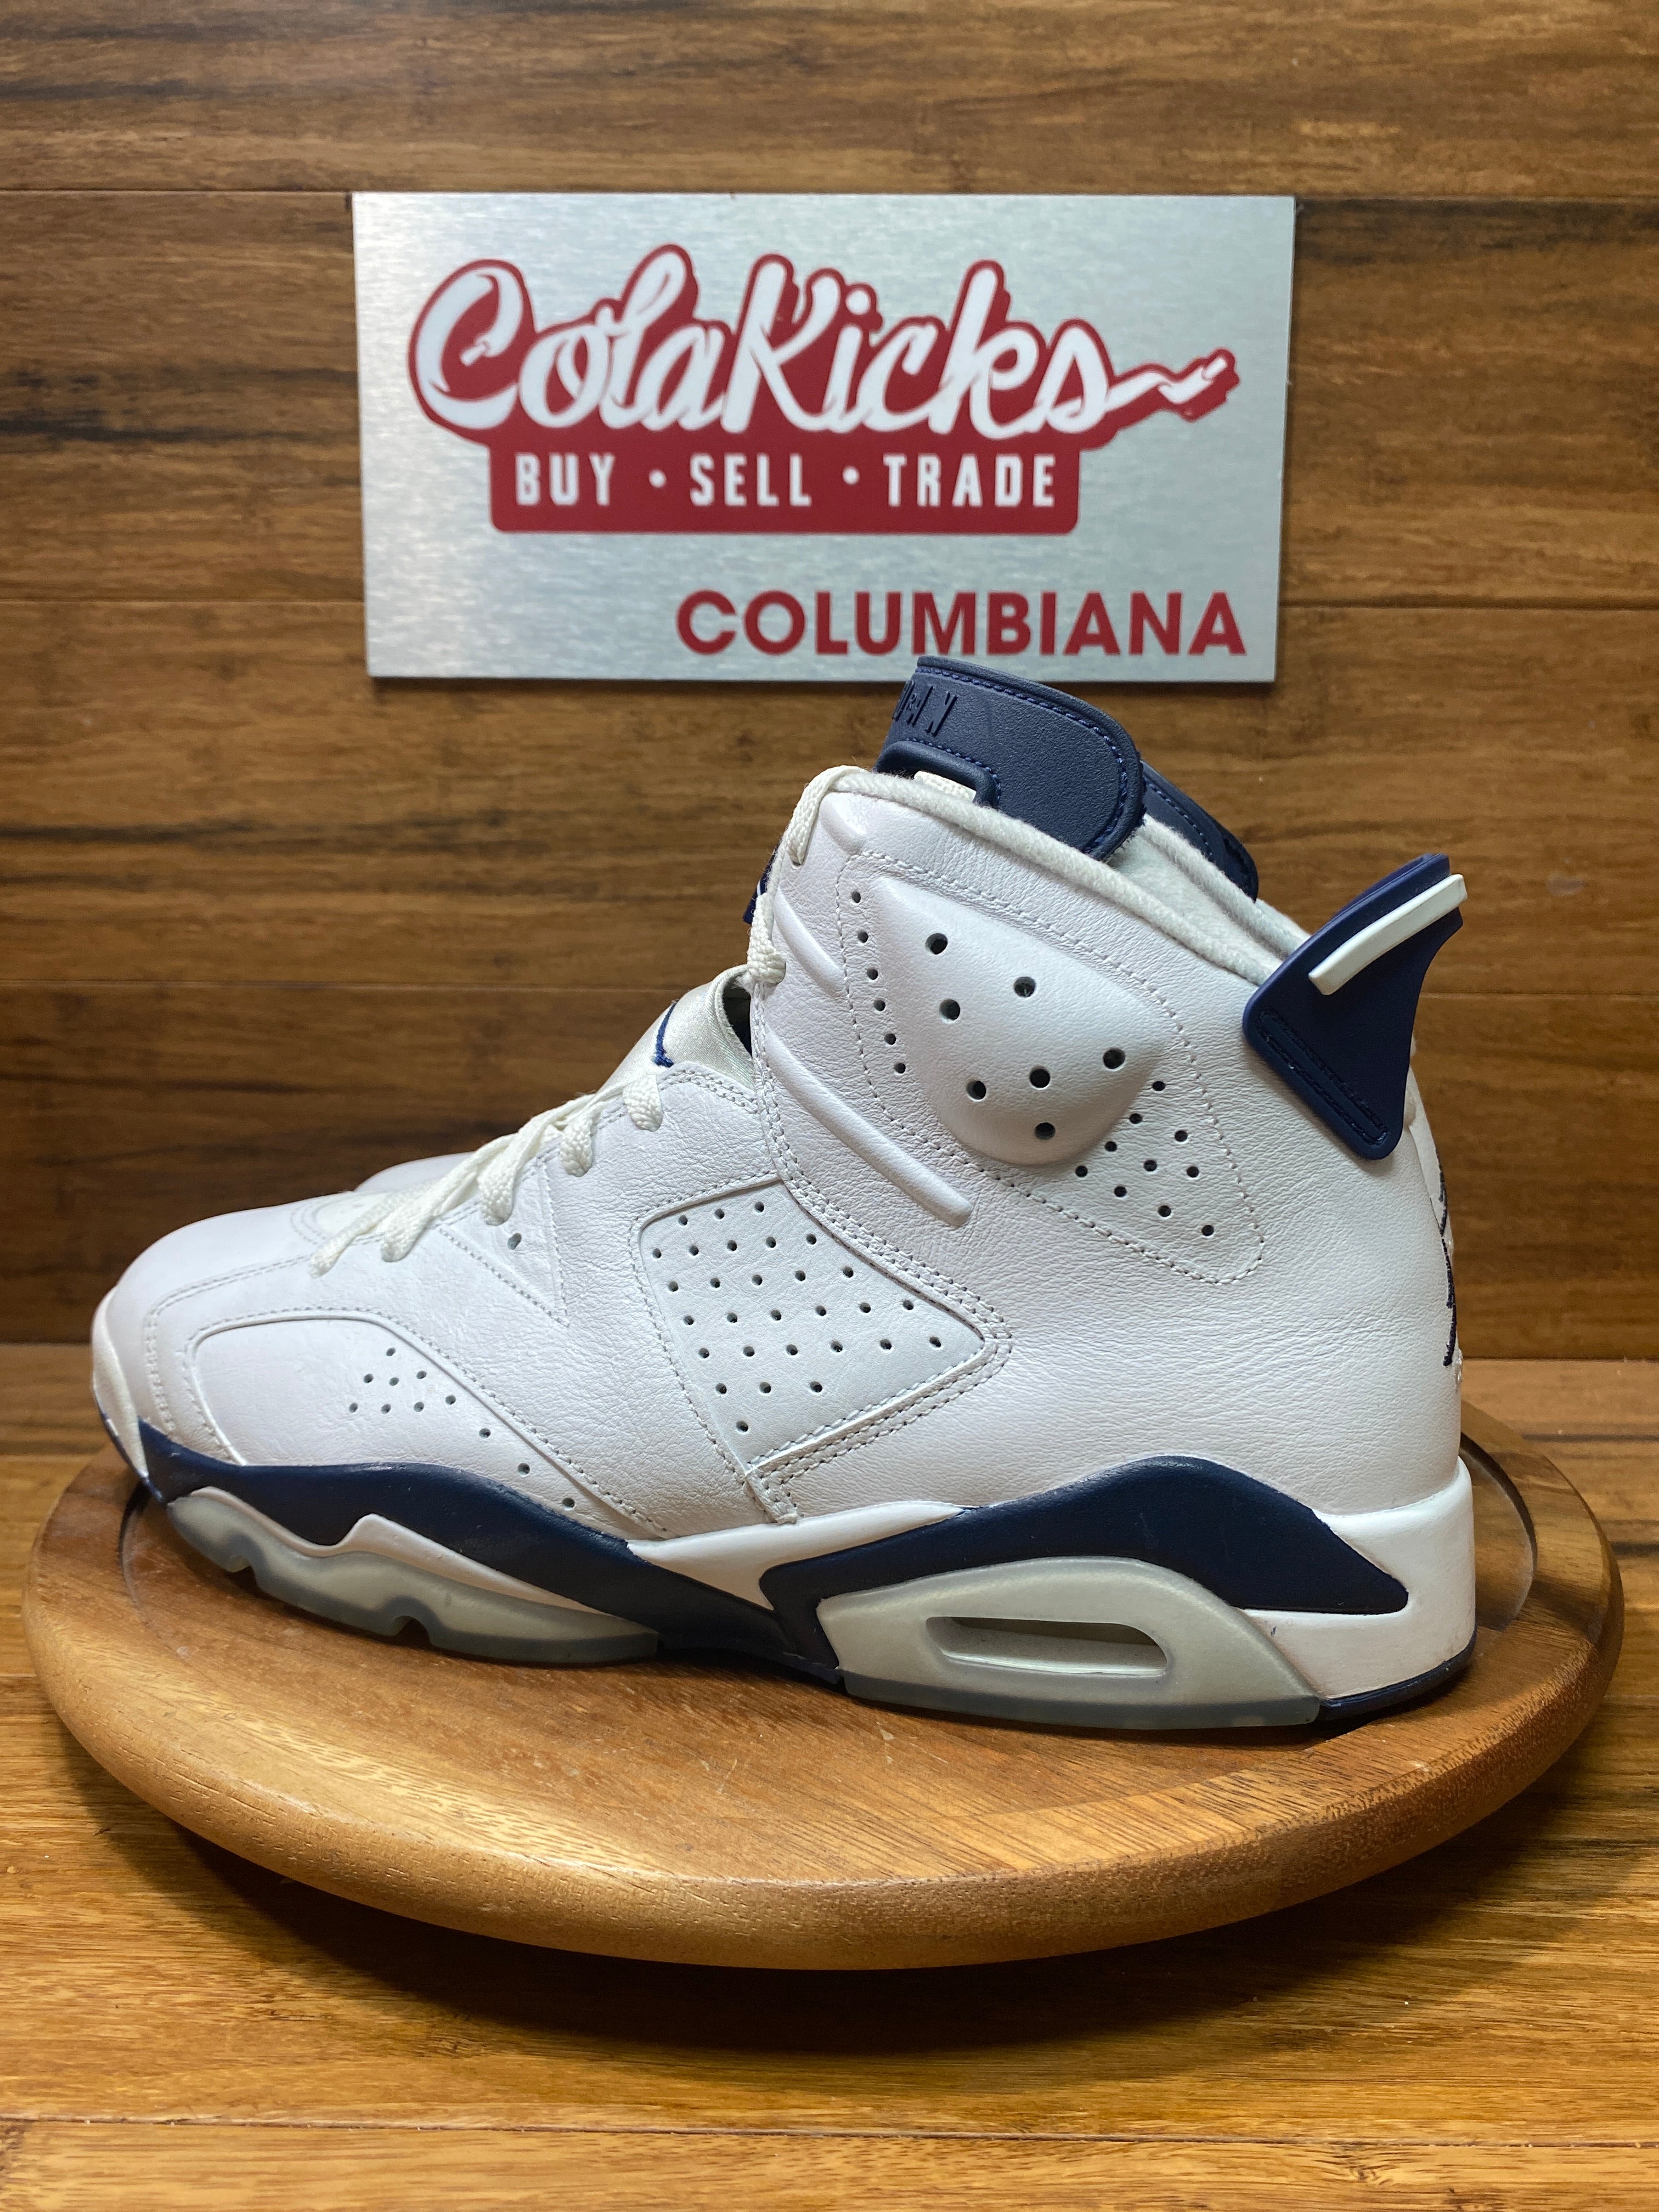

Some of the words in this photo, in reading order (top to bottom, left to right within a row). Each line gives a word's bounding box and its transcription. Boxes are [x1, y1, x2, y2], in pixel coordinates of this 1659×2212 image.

[411, 245, 1235, 441] ColaKicks
[515, 452, 616, 507] BUY
[689, 452, 813, 508] SELL
[882, 453, 1057, 509] TRADE
[676, 590, 1246, 655] COLUMBIANA
